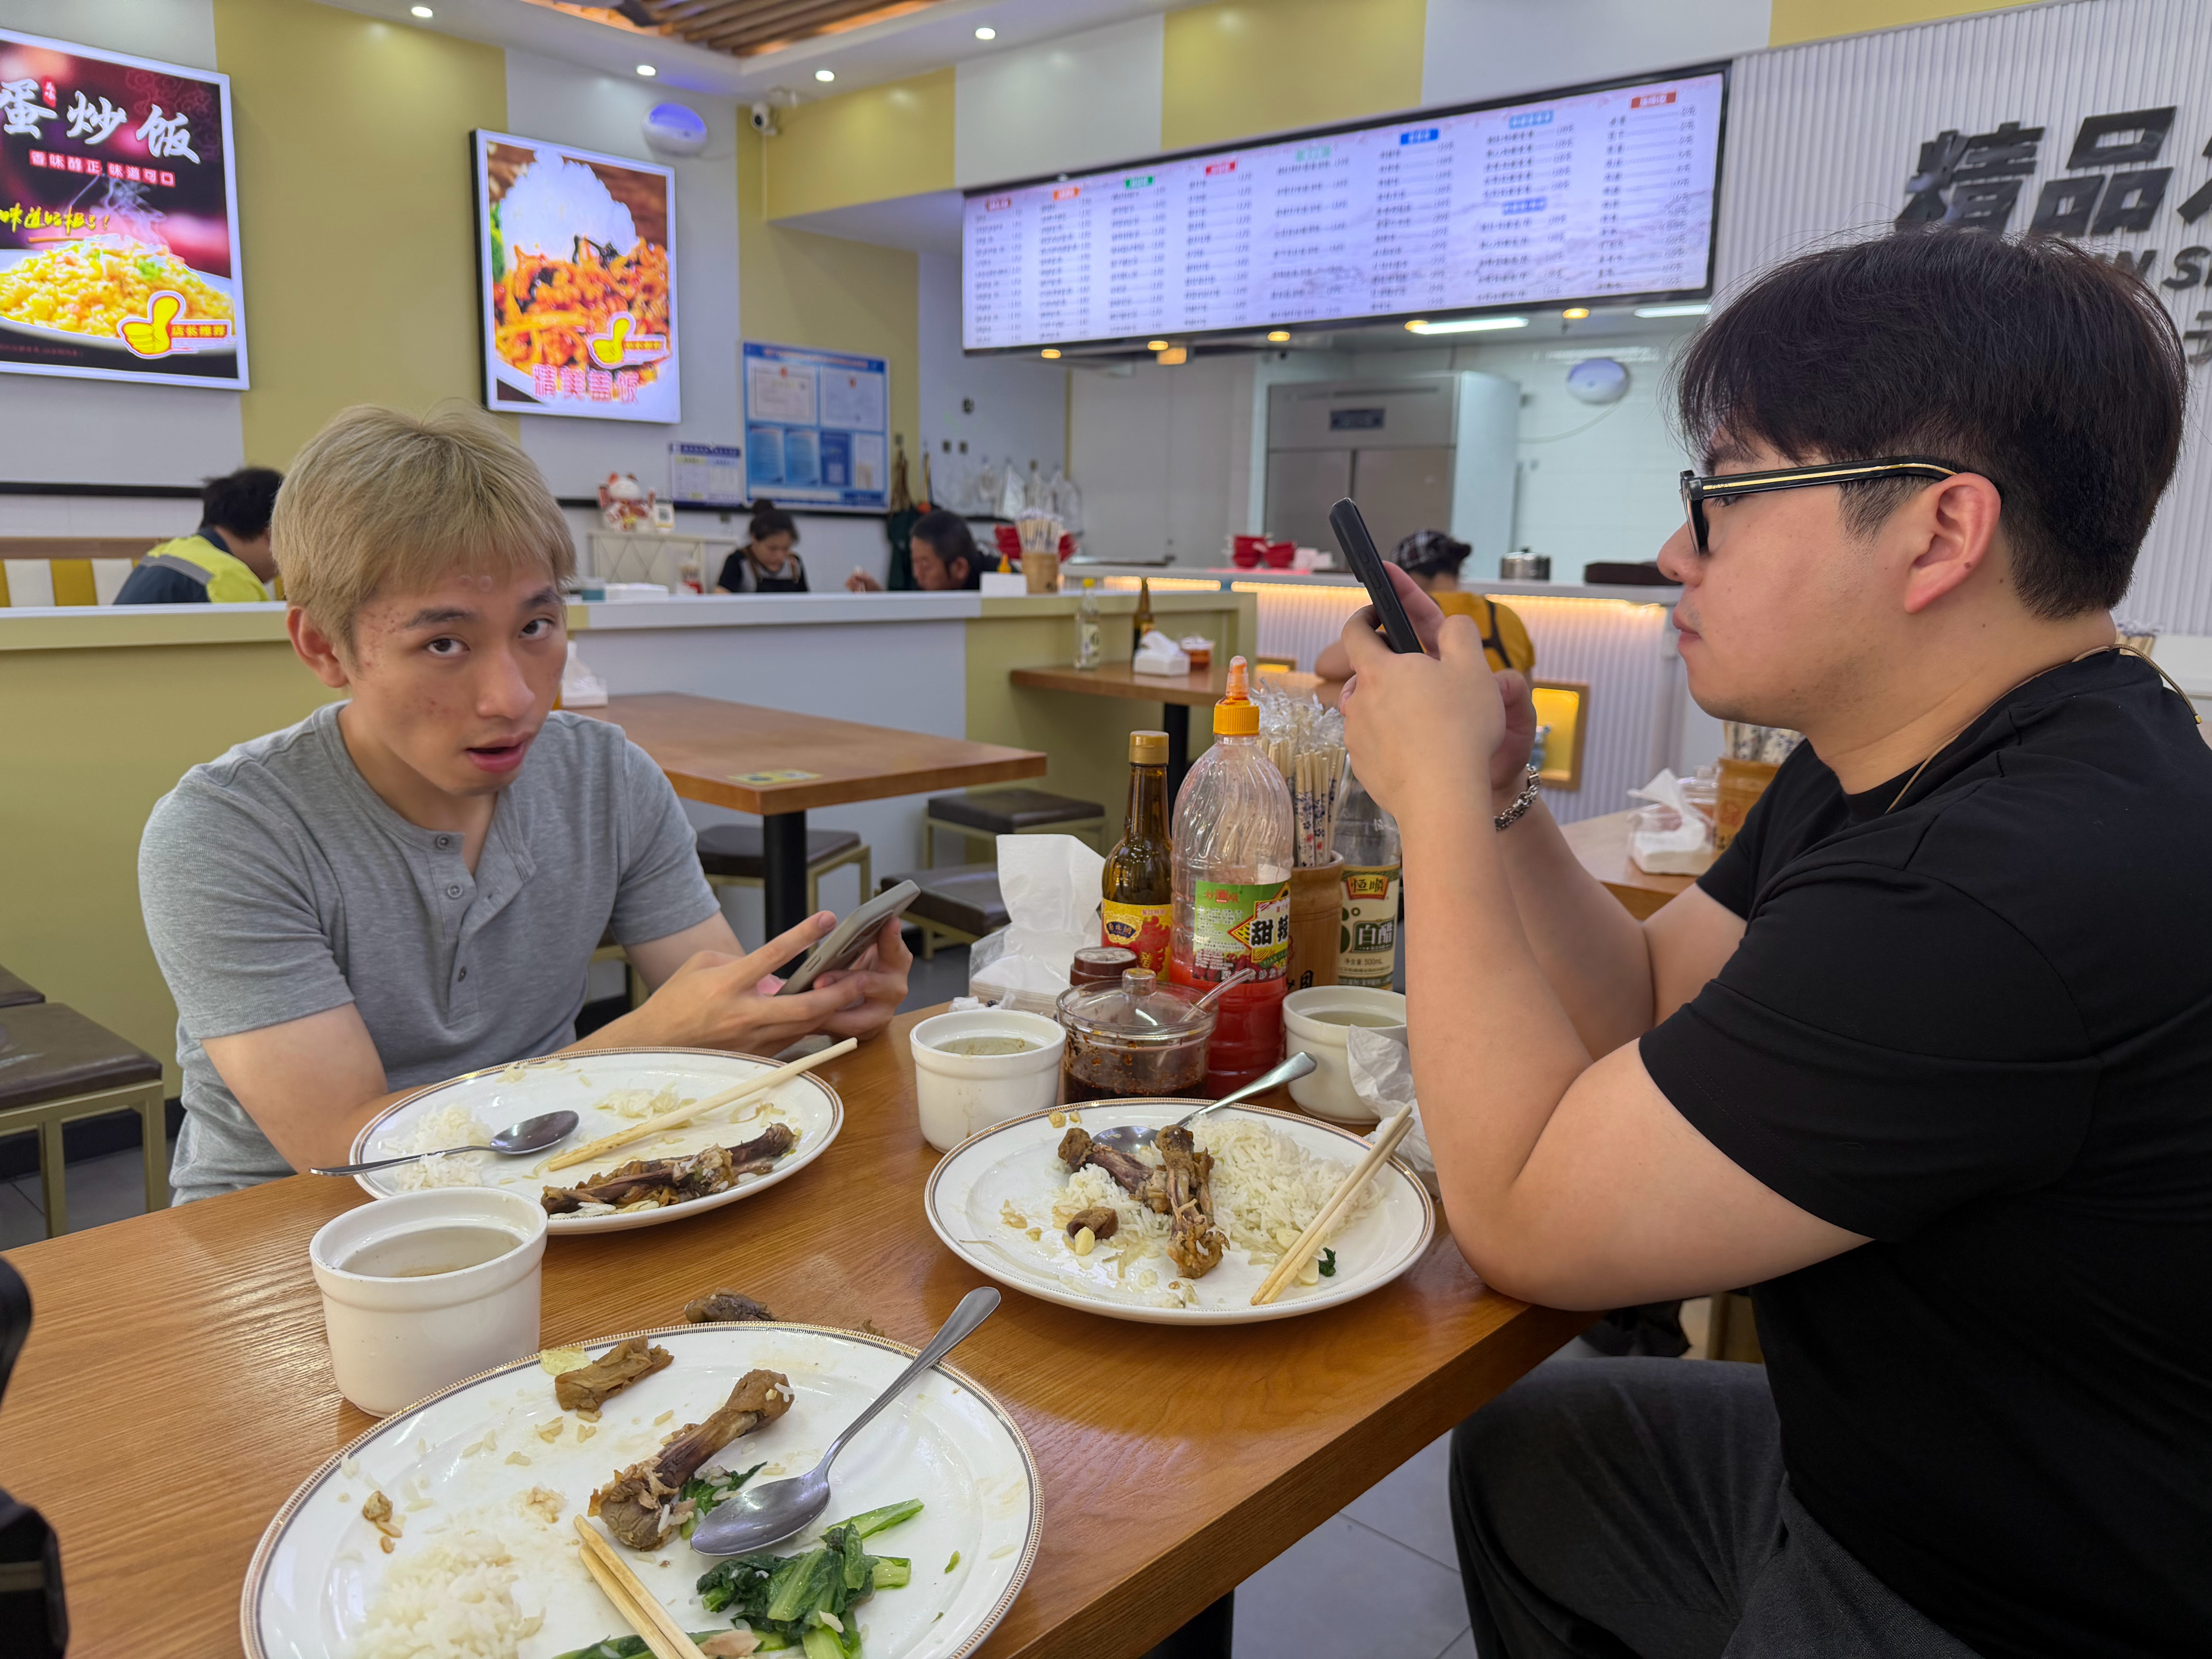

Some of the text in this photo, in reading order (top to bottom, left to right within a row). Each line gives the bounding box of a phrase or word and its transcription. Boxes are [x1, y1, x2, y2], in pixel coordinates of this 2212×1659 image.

[0, 79, 201, 164] 蛋炒饭
[109, 163, 174, 186] 味道可口
[1894, 105, 2212, 237] 精品
[2160, 245, 2212, 290] S
[1358, 921, 1393, 946] 白醋
